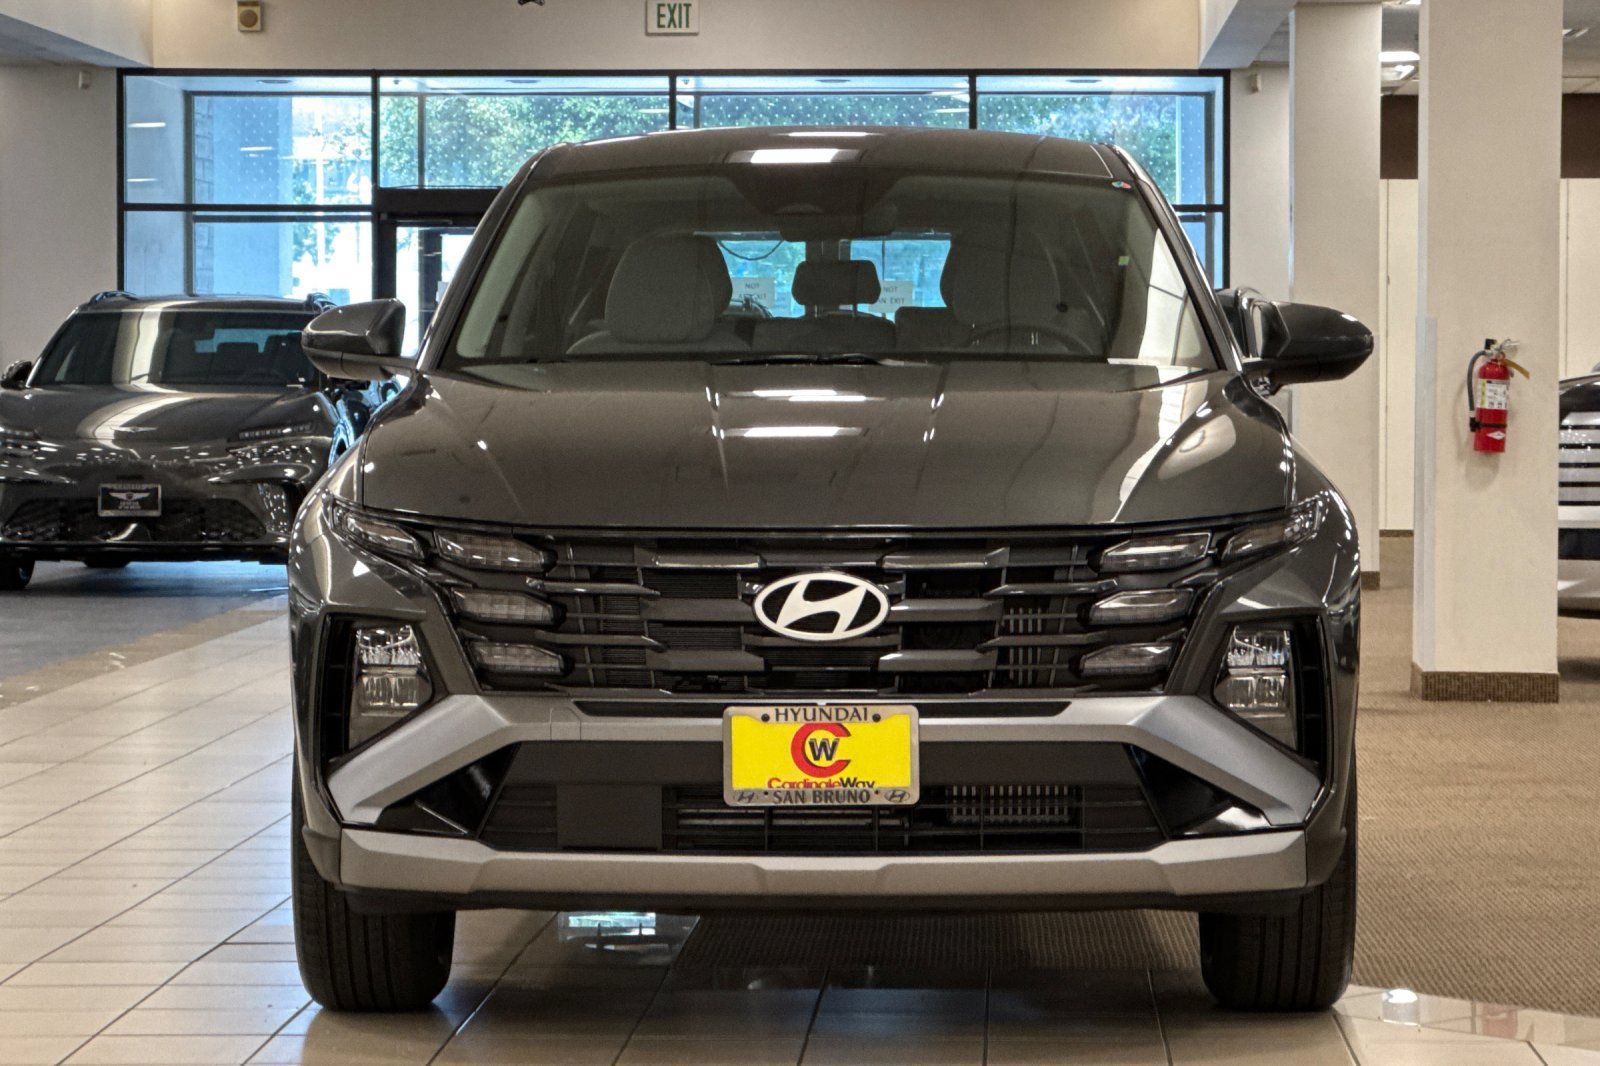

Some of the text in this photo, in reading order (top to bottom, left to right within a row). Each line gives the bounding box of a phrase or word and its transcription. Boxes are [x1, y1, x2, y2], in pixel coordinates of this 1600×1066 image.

[657, 3, 692, 28] EXIT
[775, 707, 868, 722] HYUNDAI
[773, 789, 871, 804] SAN BRUNO
